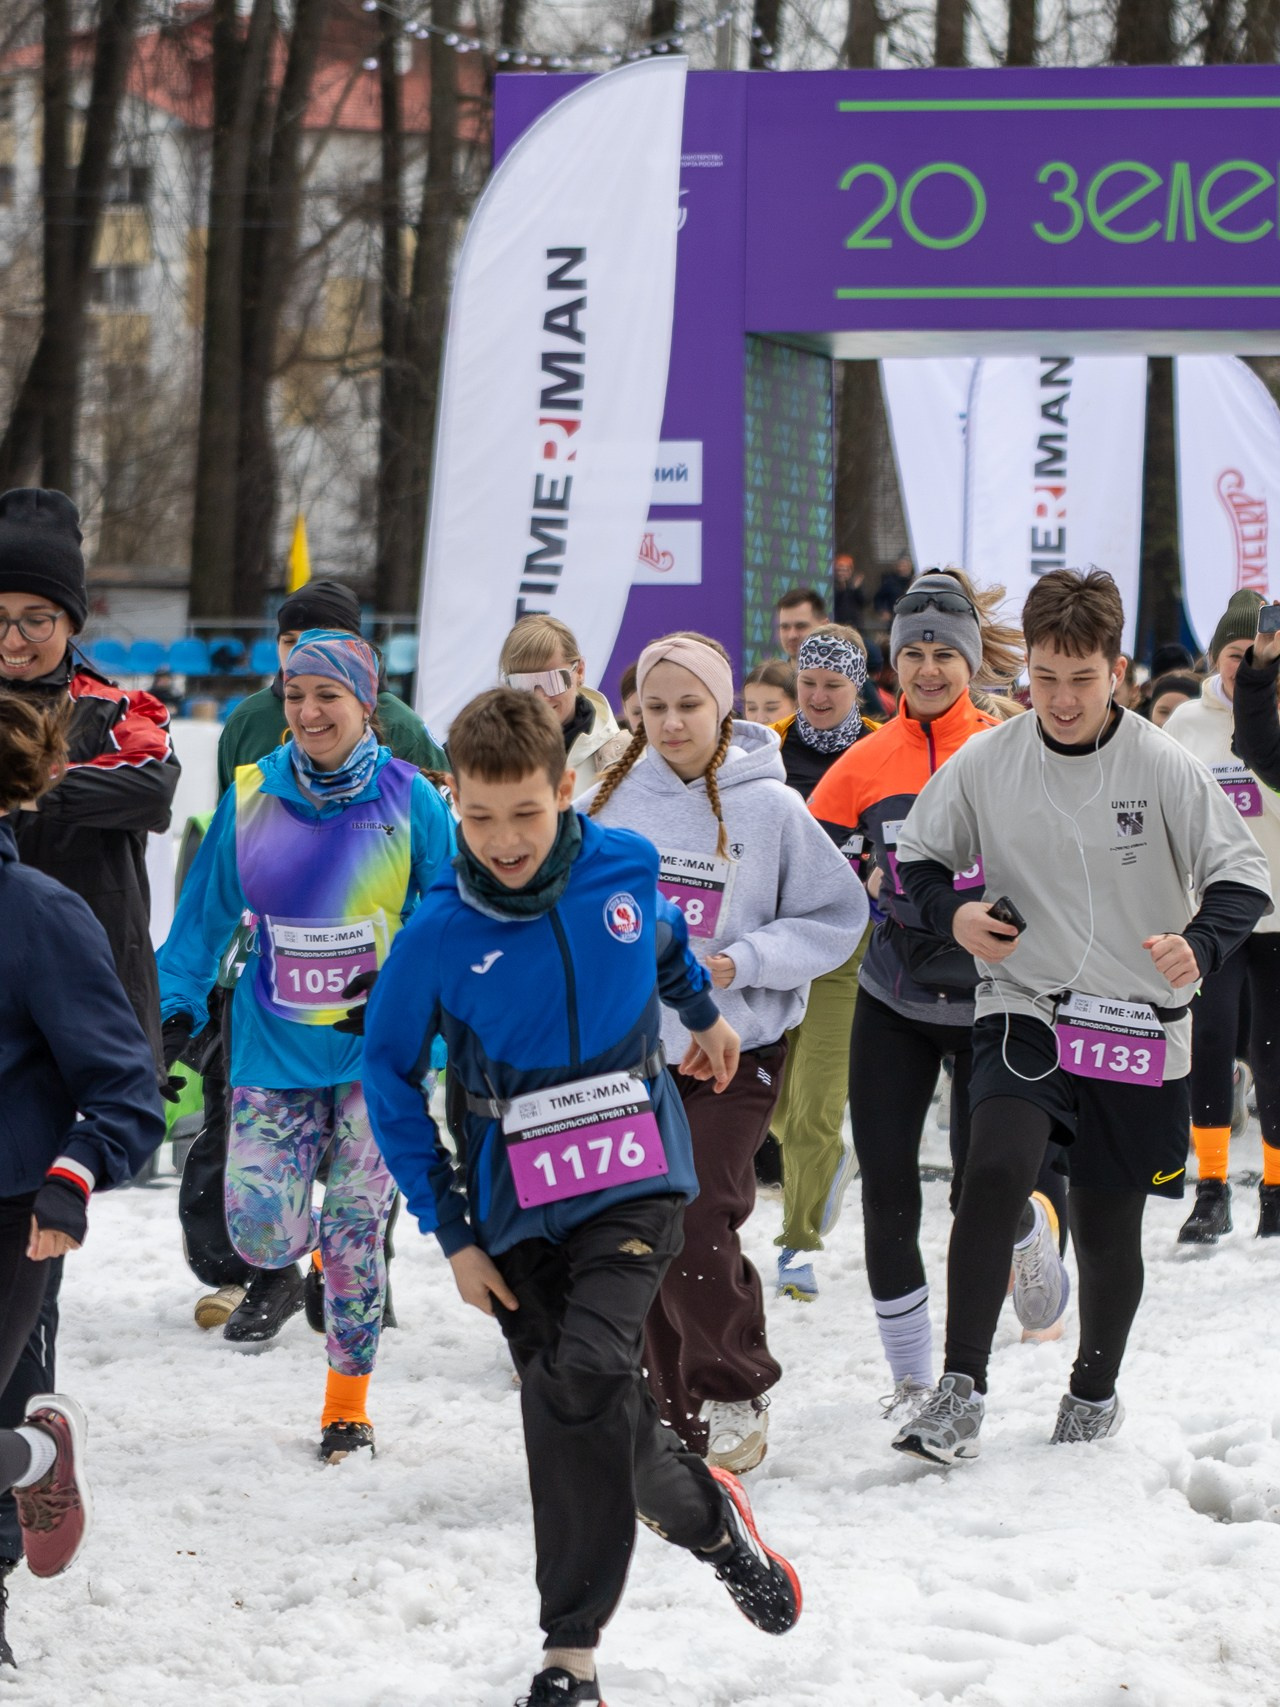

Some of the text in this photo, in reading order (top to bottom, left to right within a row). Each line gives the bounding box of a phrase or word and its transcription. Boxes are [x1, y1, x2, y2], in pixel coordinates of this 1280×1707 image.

[839, 162, 987, 250] 20
[1069, 1019, 1129, 1034] ЗЕЛЕНОДОЛЬСКИЙ
[1129, 1028, 1149, 1037] ТРЕЙЛ
[1069, 1038, 1151, 1075] 1133
[521, 1113, 599, 1140] ЗЕЛЕНОДОЛЬСКИЙ
[599, 1108, 626, 1123] ТРЕЙЛ
[533, 1131, 646, 1187] 1176
